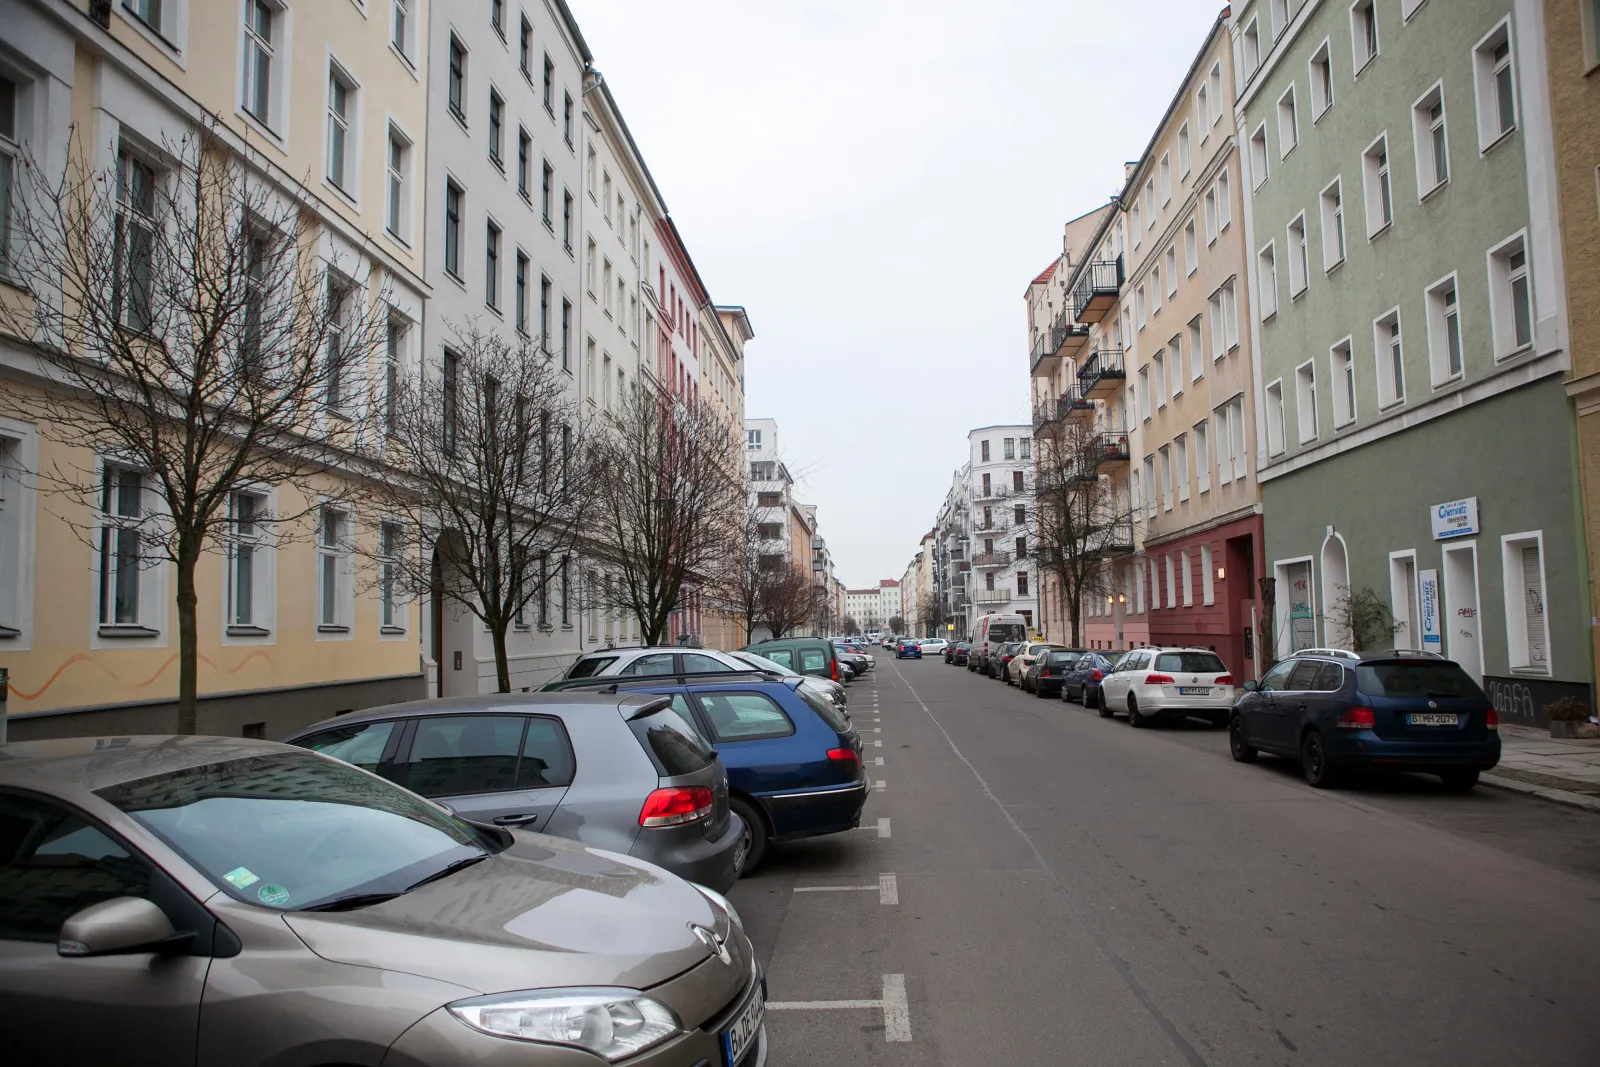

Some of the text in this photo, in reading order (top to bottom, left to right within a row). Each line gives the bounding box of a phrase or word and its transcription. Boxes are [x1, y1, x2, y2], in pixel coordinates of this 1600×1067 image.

[1439, 505, 1467, 519] Chemnitz
[1424, 581, 1432, 632] Chemnitz
[1411, 714, 1457, 723] B MH 2079
[731, 1028, 738, 1057] B
